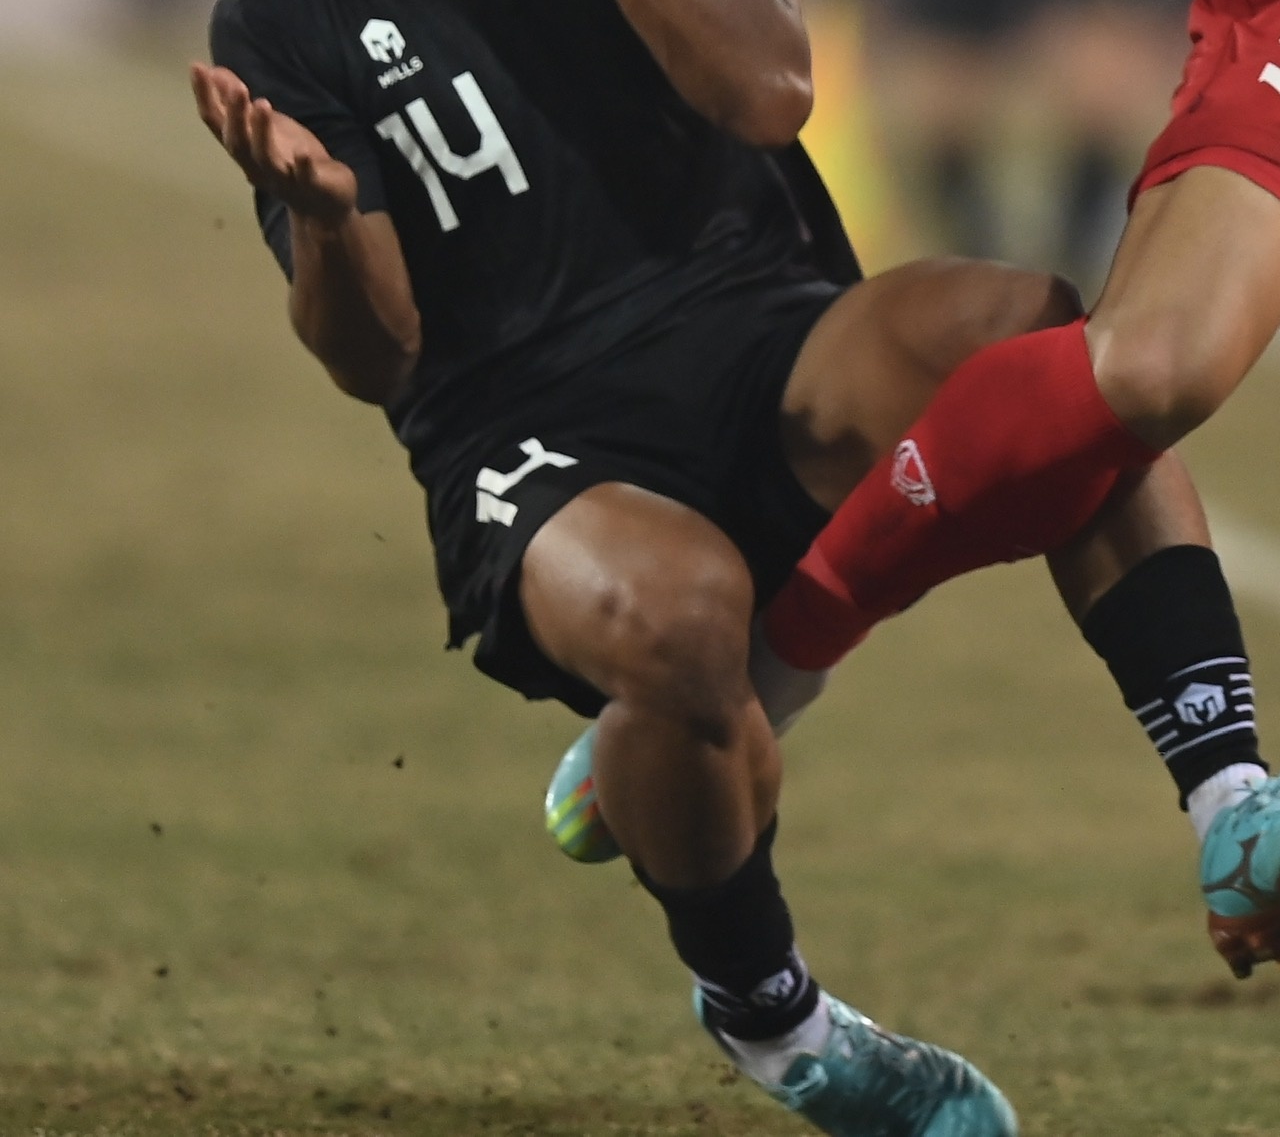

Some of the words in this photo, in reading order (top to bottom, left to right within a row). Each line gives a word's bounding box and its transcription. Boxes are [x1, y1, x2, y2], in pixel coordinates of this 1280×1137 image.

[377, 55, 424, 89] MILLS
[374, 70, 530, 232] 14
[475, 436, 580, 528] 14
